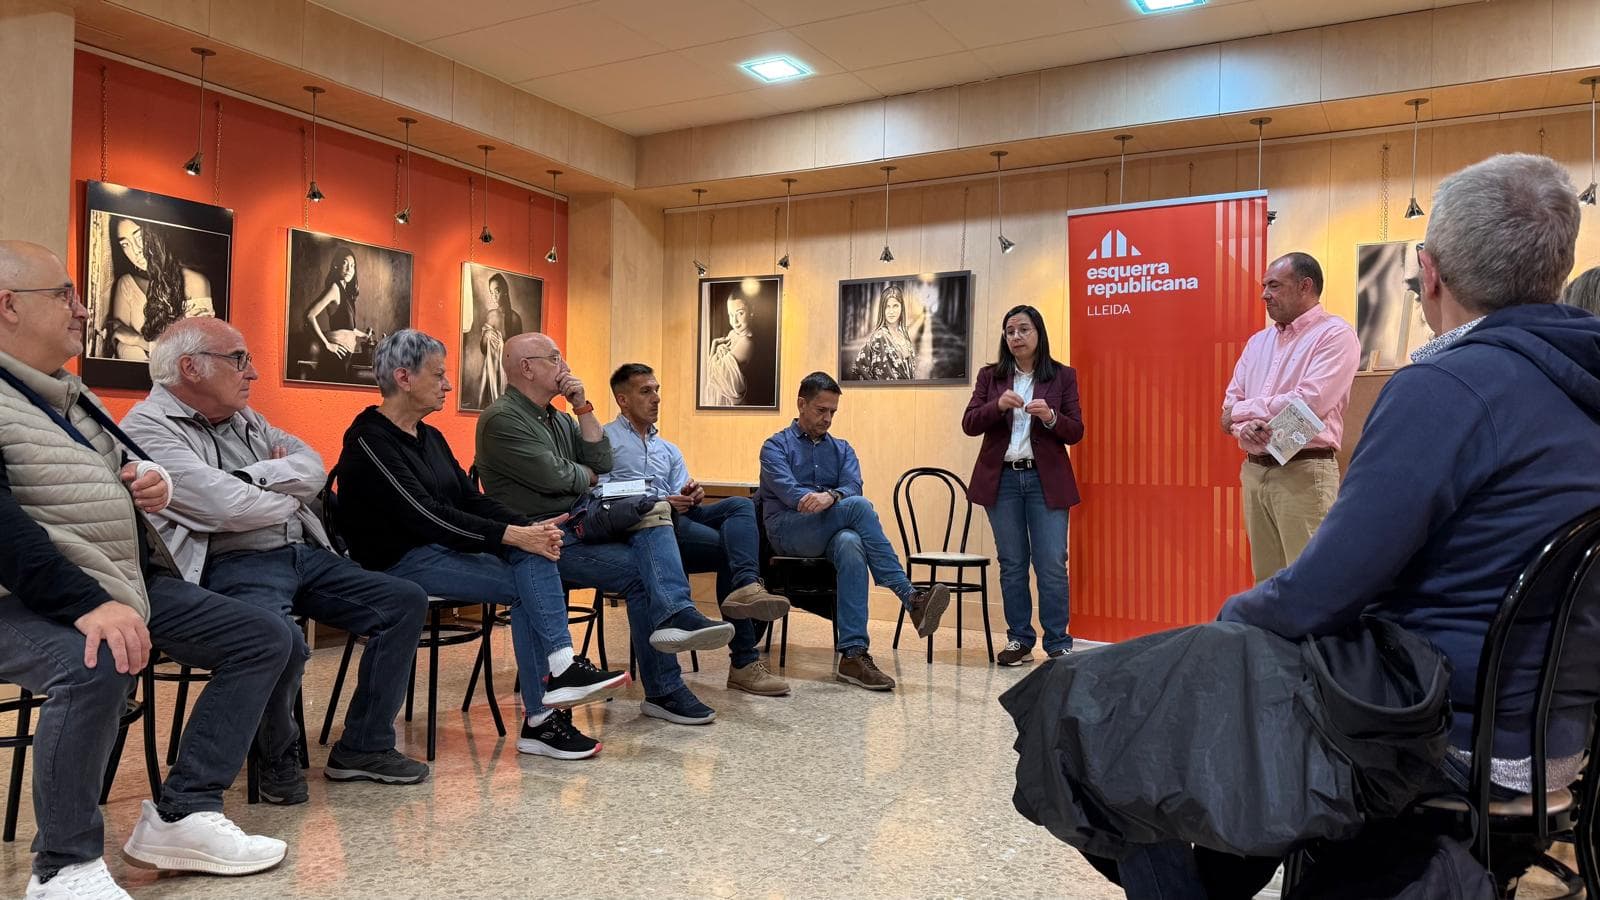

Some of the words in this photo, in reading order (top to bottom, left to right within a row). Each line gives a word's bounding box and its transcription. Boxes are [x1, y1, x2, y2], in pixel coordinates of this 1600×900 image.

[1087, 262, 1169, 281] esquerra
[1087, 276, 1198, 298] republicana
[1087, 304, 1131, 316] LLEIDA
